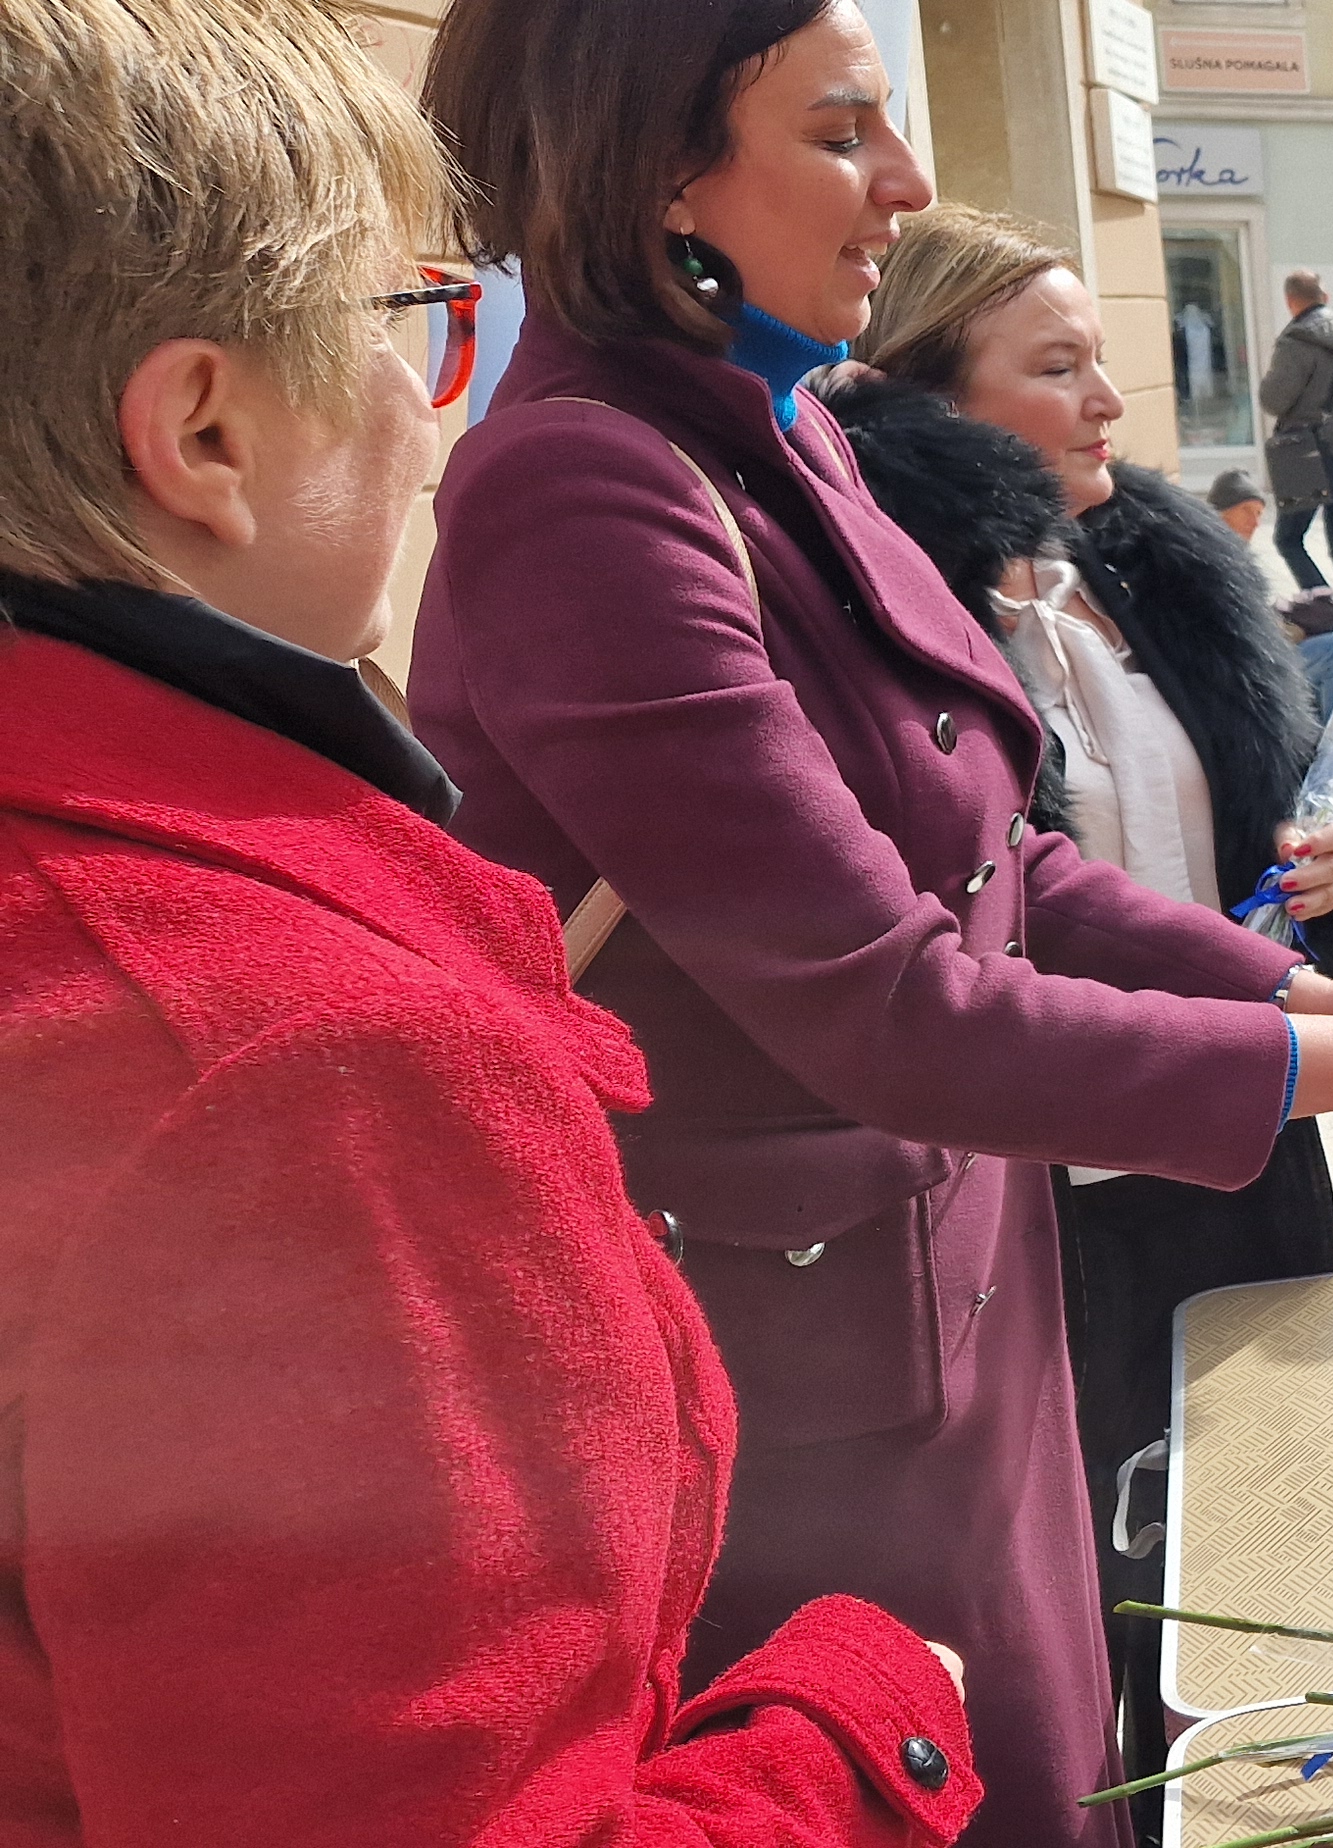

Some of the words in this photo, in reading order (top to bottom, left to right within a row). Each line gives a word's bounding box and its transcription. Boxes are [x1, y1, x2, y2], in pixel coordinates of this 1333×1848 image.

[1169, 57, 1222, 70] SLUŠNA
[1224, 59, 1300, 72] POMAGALA
[1153, 138, 1249, 187] orka
